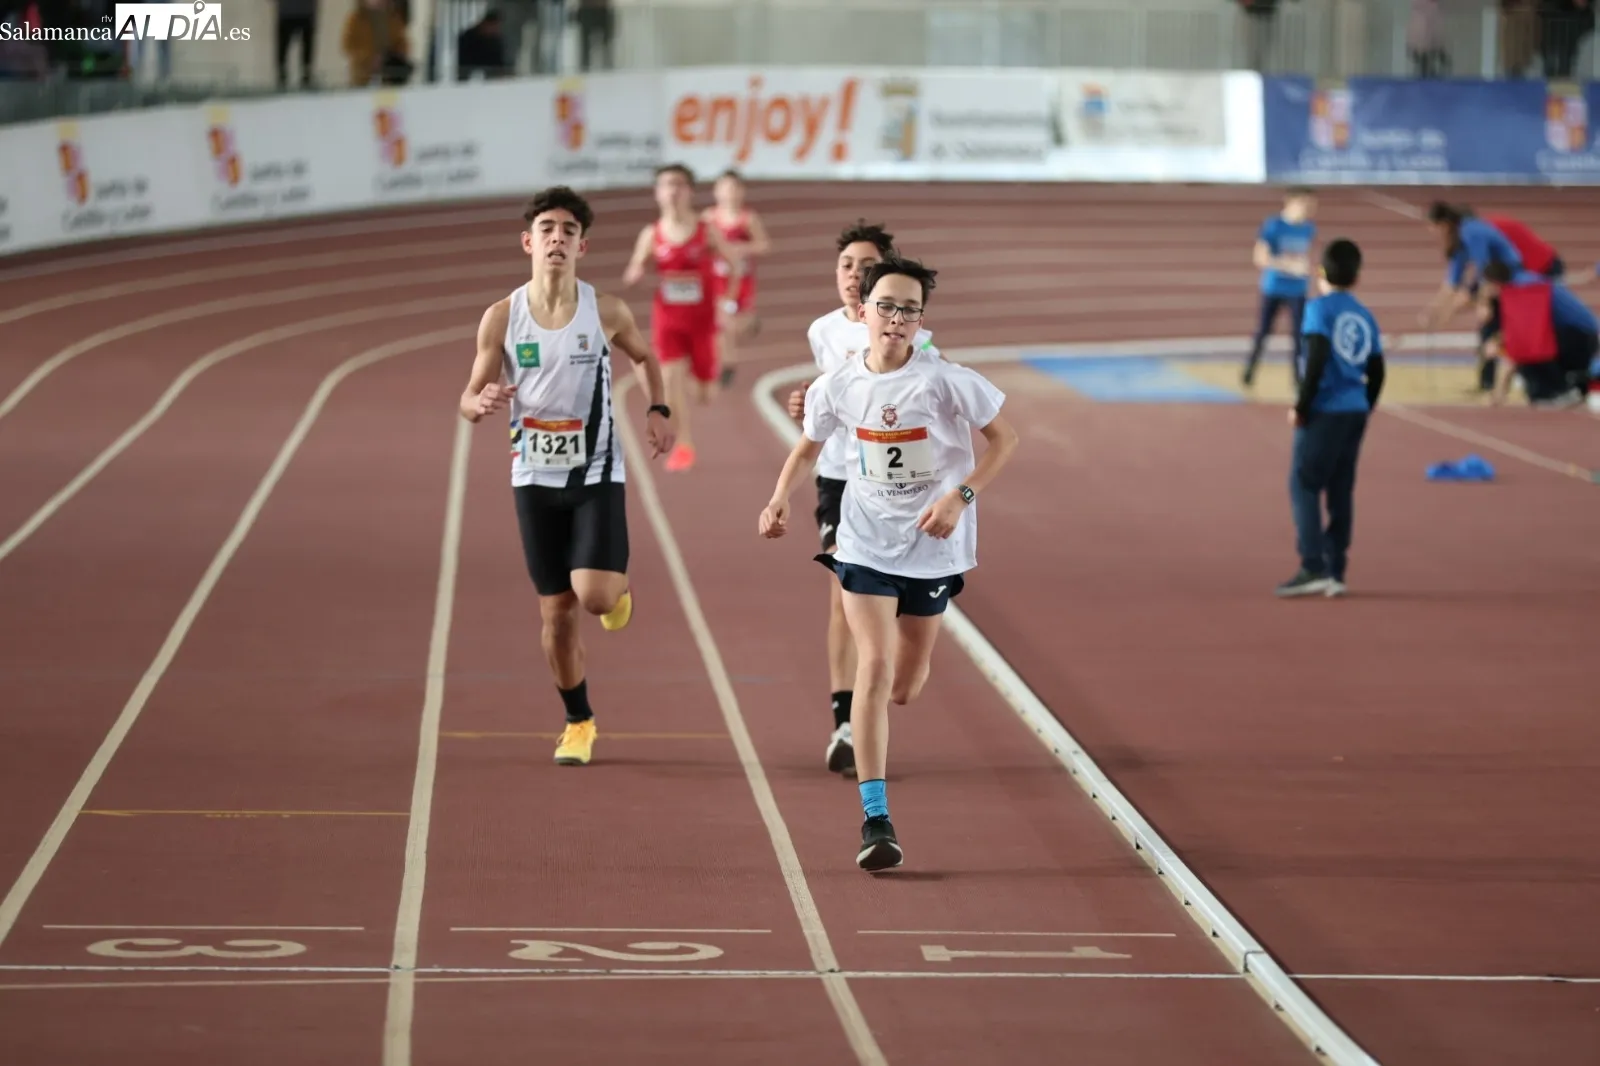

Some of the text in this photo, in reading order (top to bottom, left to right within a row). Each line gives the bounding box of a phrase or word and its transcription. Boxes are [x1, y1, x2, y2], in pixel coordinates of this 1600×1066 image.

[671, 76, 859, 163] enjoy!
[529, 432, 580, 455] 1321
[886, 446, 904, 468] 2
[86, 937, 307, 959] 3
[507, 939, 725, 962] 2
[920, 945, 1132, 962] 1
